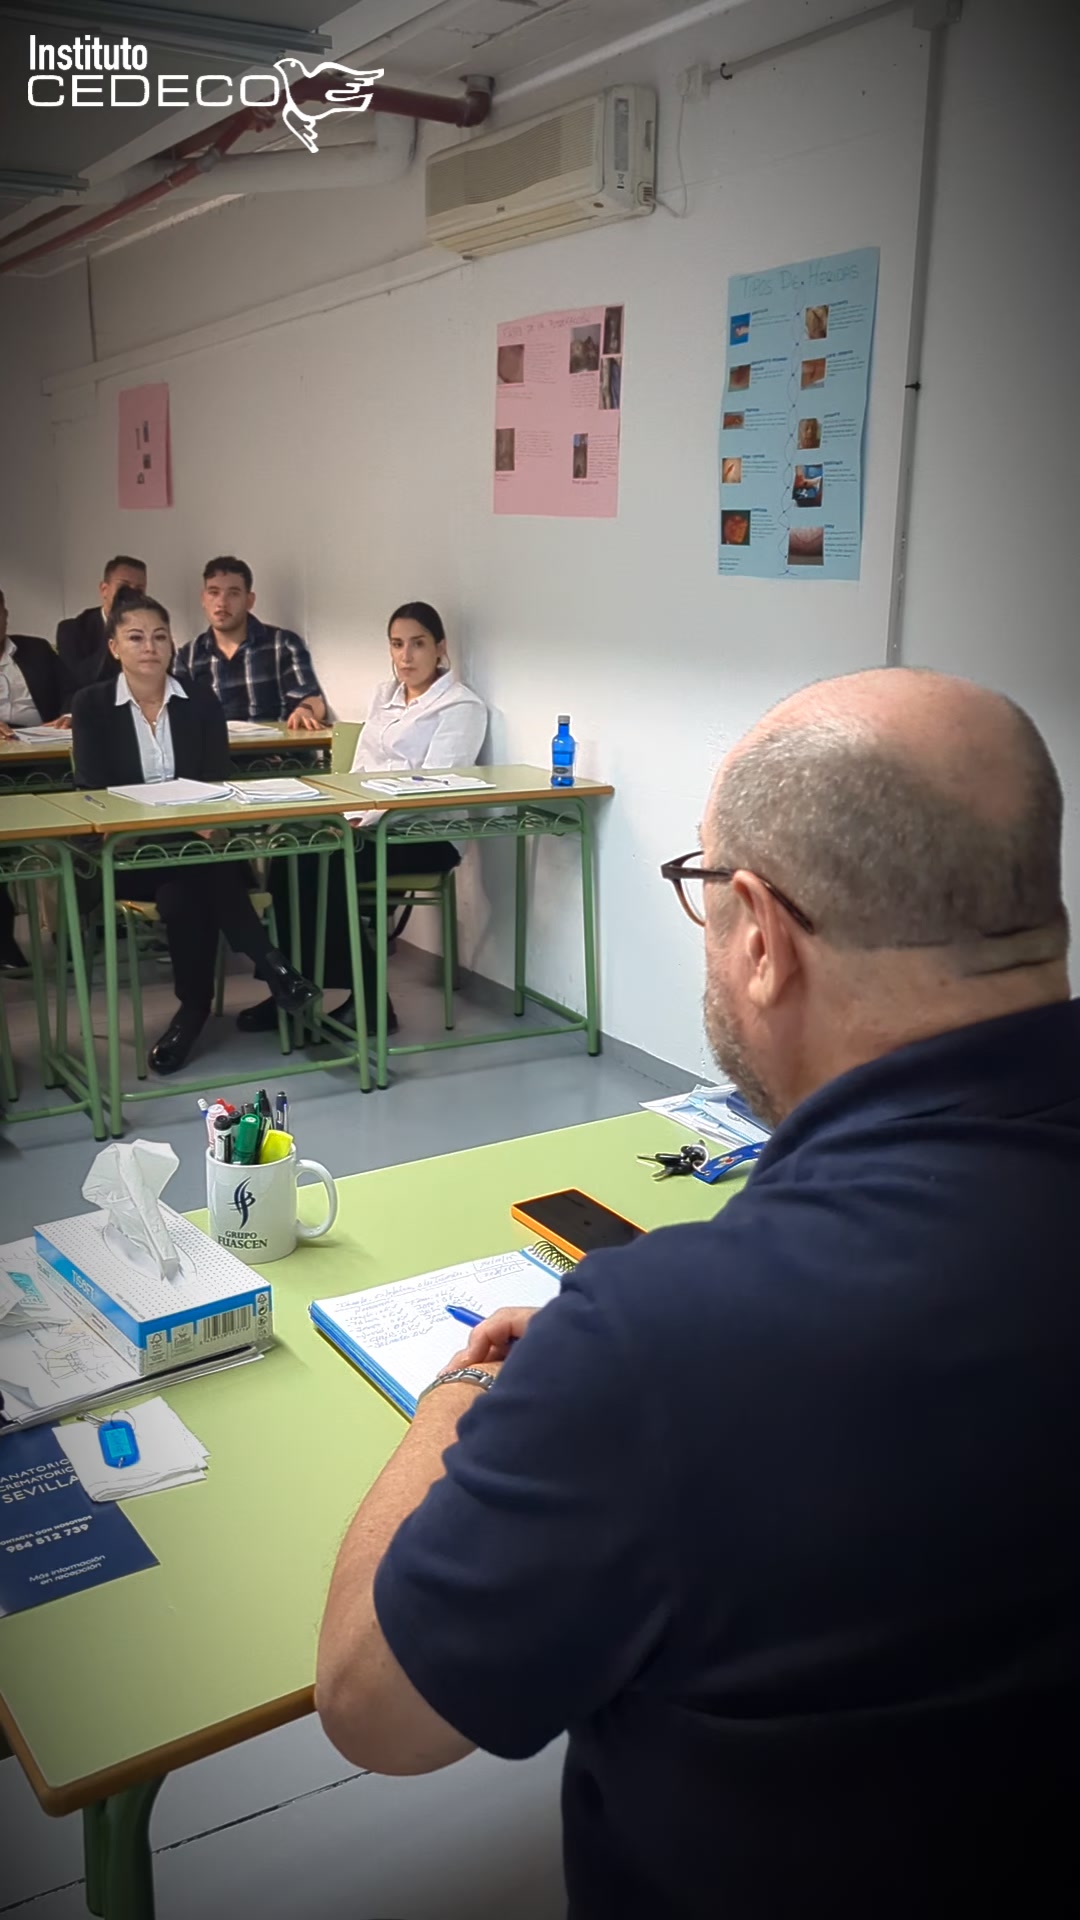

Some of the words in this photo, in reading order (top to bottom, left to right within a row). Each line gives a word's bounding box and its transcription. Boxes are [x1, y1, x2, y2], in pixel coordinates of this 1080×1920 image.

[217, 1236, 268, 1249] FUASCEN
[225, 1230, 258, 1240] GRUPO
[1, 1475, 79, 1504] SEVILLA
[53, 1515, 93, 1530] NOSOTROS
[6, 1541, 33, 1553] 954
[35, 1532, 62, 1545] 512
[63, 1523, 89, 1536] 739
[51, 1554, 106, 1576] información
[54, 1561, 102, 1581] recepción
